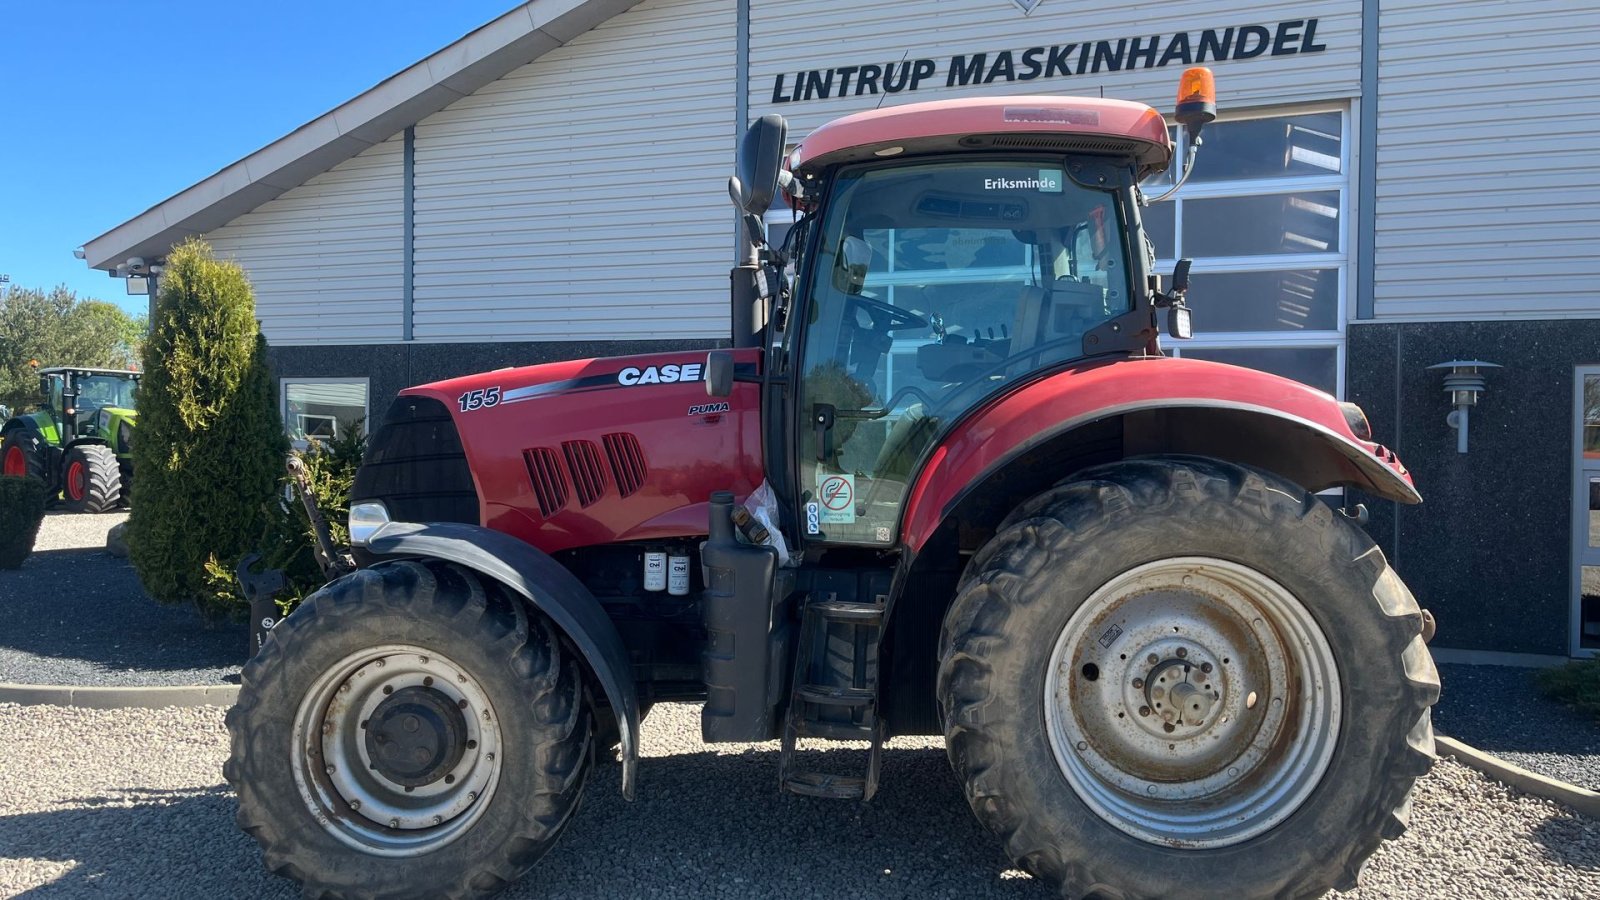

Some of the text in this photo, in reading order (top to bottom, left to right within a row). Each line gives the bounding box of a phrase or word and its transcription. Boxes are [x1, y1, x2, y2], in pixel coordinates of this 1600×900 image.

[771, 18, 1327, 104] LINTRUP MASKINHANDEL
[984, 177, 1056, 190] Eriksminde
[618, 363, 701, 386] CASE
[457, 385, 501, 412] 155
[688, 402, 730, 416] PUMA
